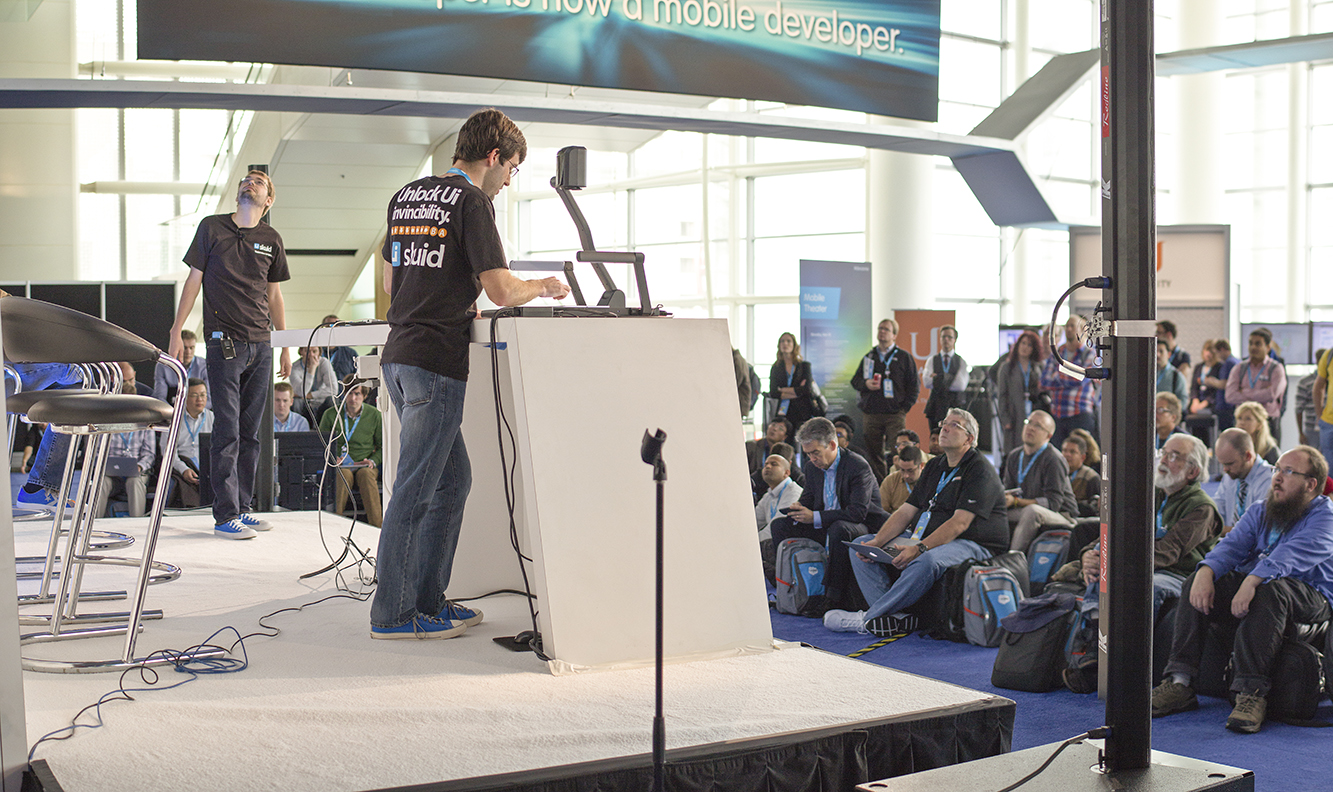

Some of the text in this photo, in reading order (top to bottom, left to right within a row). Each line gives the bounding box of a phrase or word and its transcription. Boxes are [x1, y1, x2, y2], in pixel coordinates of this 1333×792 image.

[653, 0, 756, 31] mobile
[764, 0, 904, 55] developer.
[397, 184, 443, 203] Unlock
[803, 293, 826, 302] Mobile
[803, 304, 828, 313] Theater
